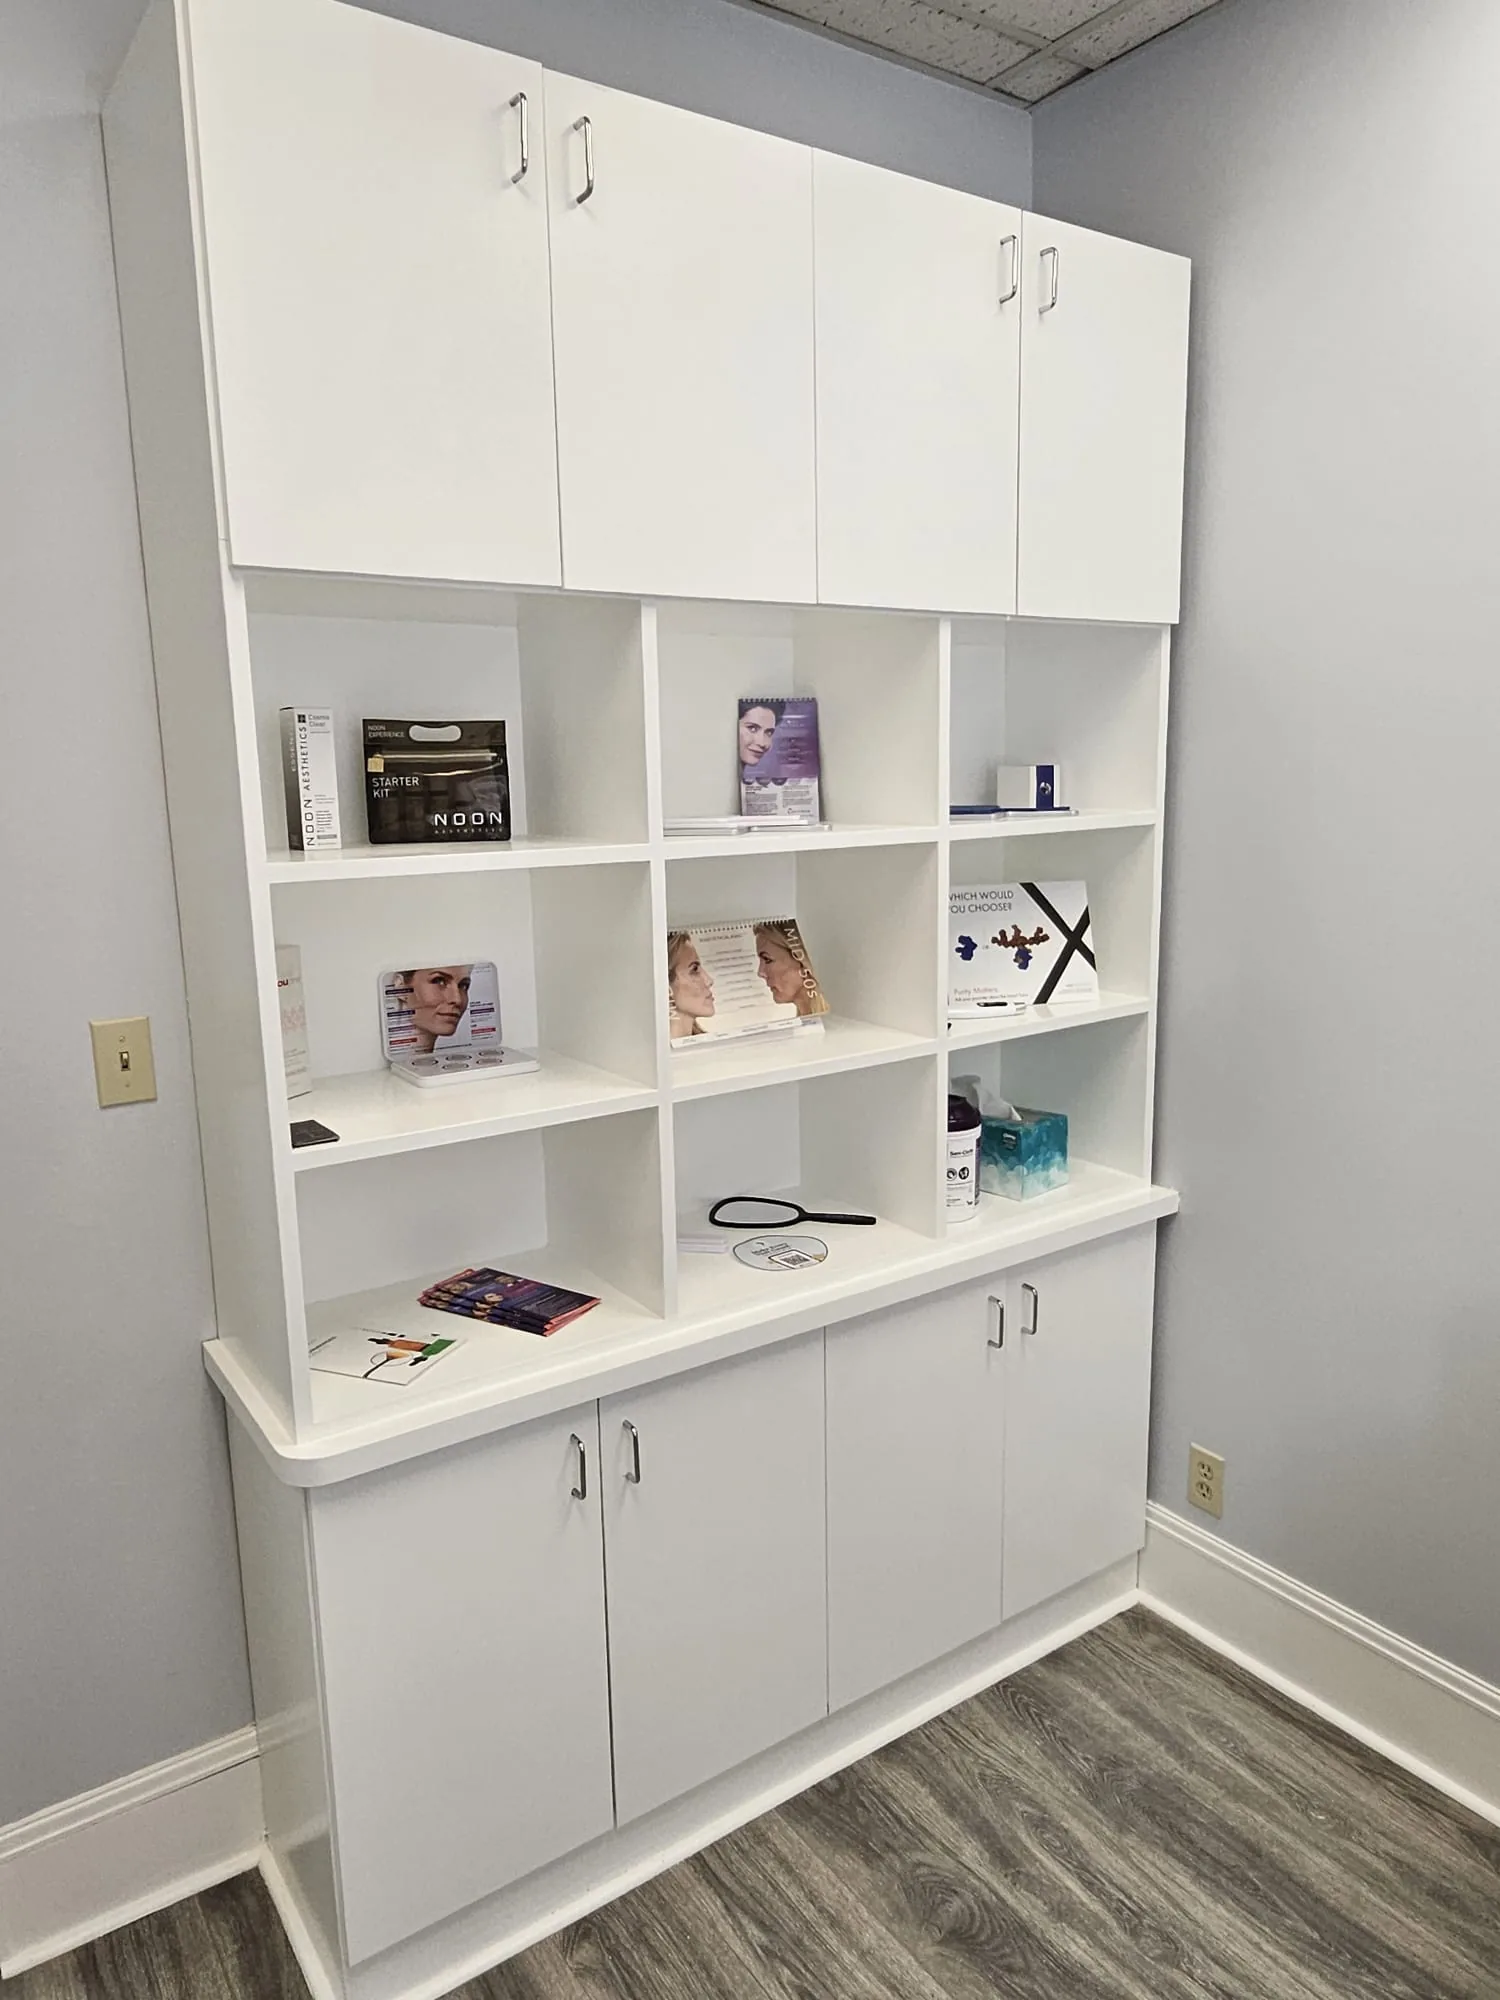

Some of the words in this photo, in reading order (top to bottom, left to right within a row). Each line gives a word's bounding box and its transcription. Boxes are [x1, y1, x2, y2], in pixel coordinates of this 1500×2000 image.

[299, 726, 311, 791] AESTHETICS
[372, 776, 420, 787] STARTER
[373, 788, 390, 798] KIT
[304, 799, 315, 847] NOON
[434, 812, 502, 826] NOON
[979, 890, 1014, 900] WOULD
[950, 904, 966, 913] OU
[784, 928, 805, 961] MID
